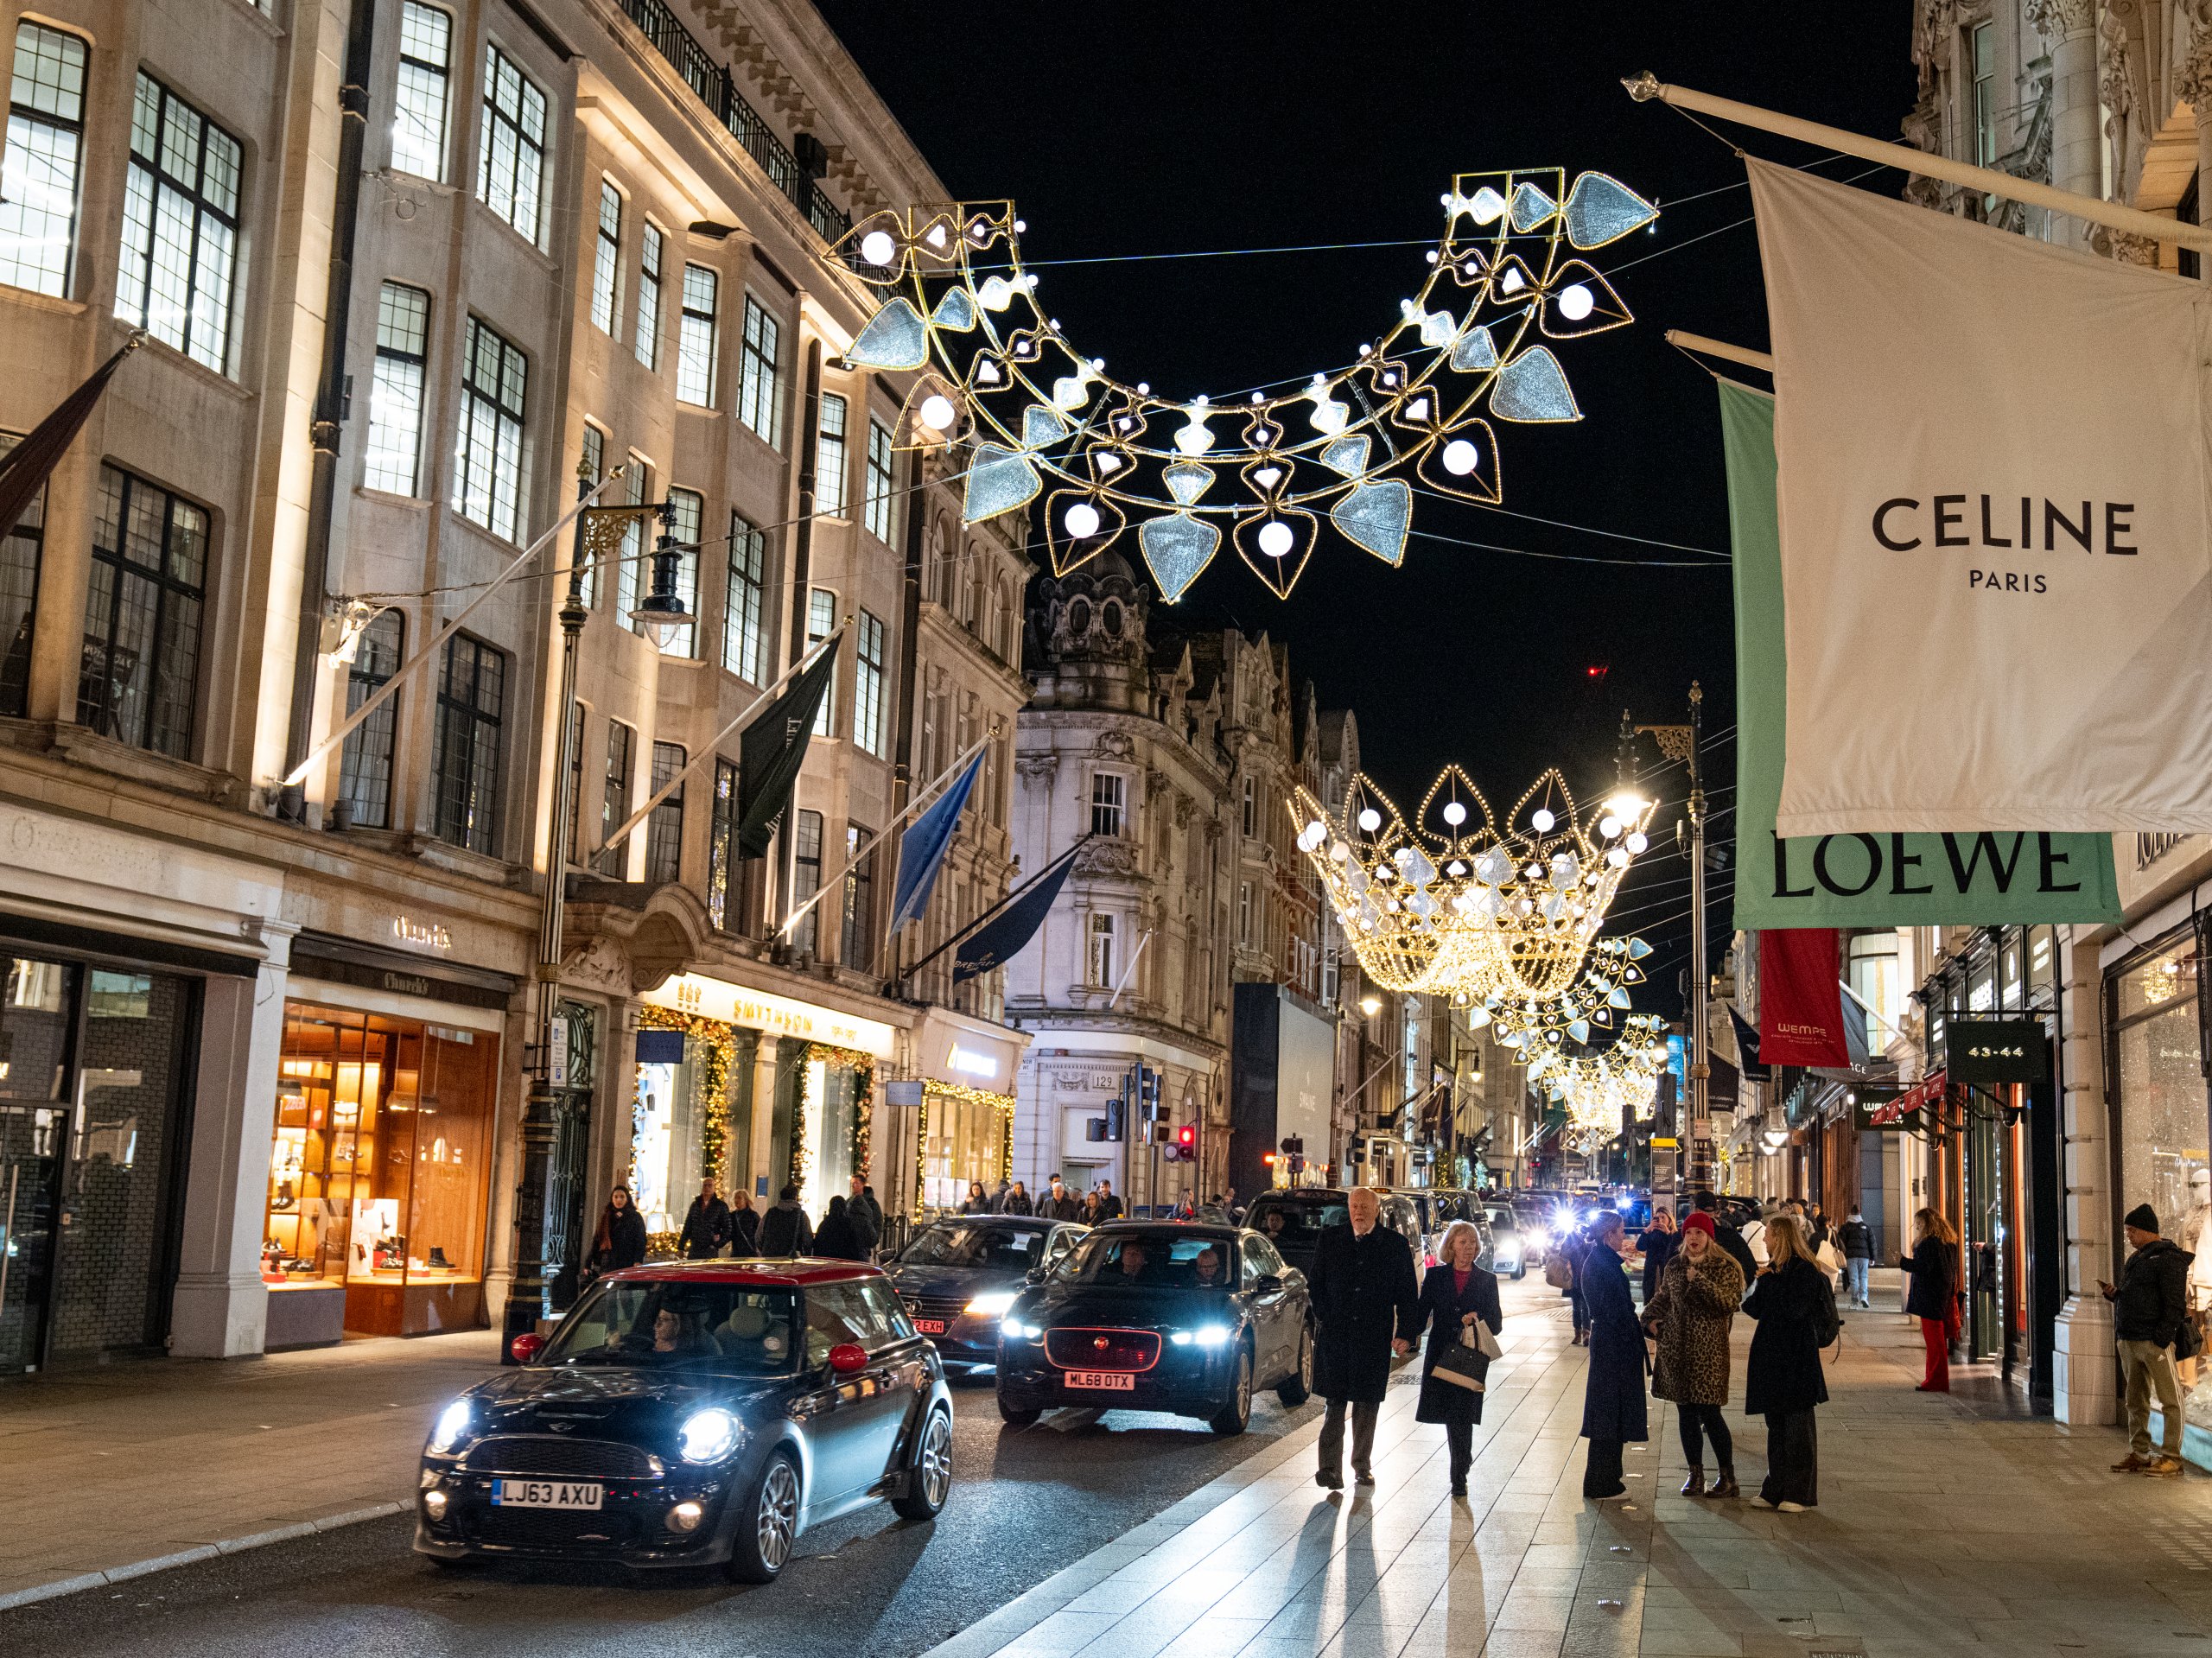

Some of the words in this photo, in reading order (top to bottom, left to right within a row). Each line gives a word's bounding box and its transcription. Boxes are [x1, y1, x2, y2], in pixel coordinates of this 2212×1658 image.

[1872, 493, 2139, 556] CELINE
[1969, 569, 2048, 594] PARIS
[1769, 829, 2082, 898] LOEWE
[384, 972, 429, 995] Church's
[733, 999, 813, 1032] SMYTHSON
[1777, 1023, 1827, 1038] WEMPE
[1968, 1046, 2024, 1058] 43-44
[1096, 1076, 1113, 1087] 129
[923, 1321, 943, 1331] EXH
[1070, 1374, 1101, 1387] ML68
[1104, 1375, 1128, 1388] OTX
[502, 1481, 553, 1503] LJ63
[557, 1484, 598, 1505] AXU
